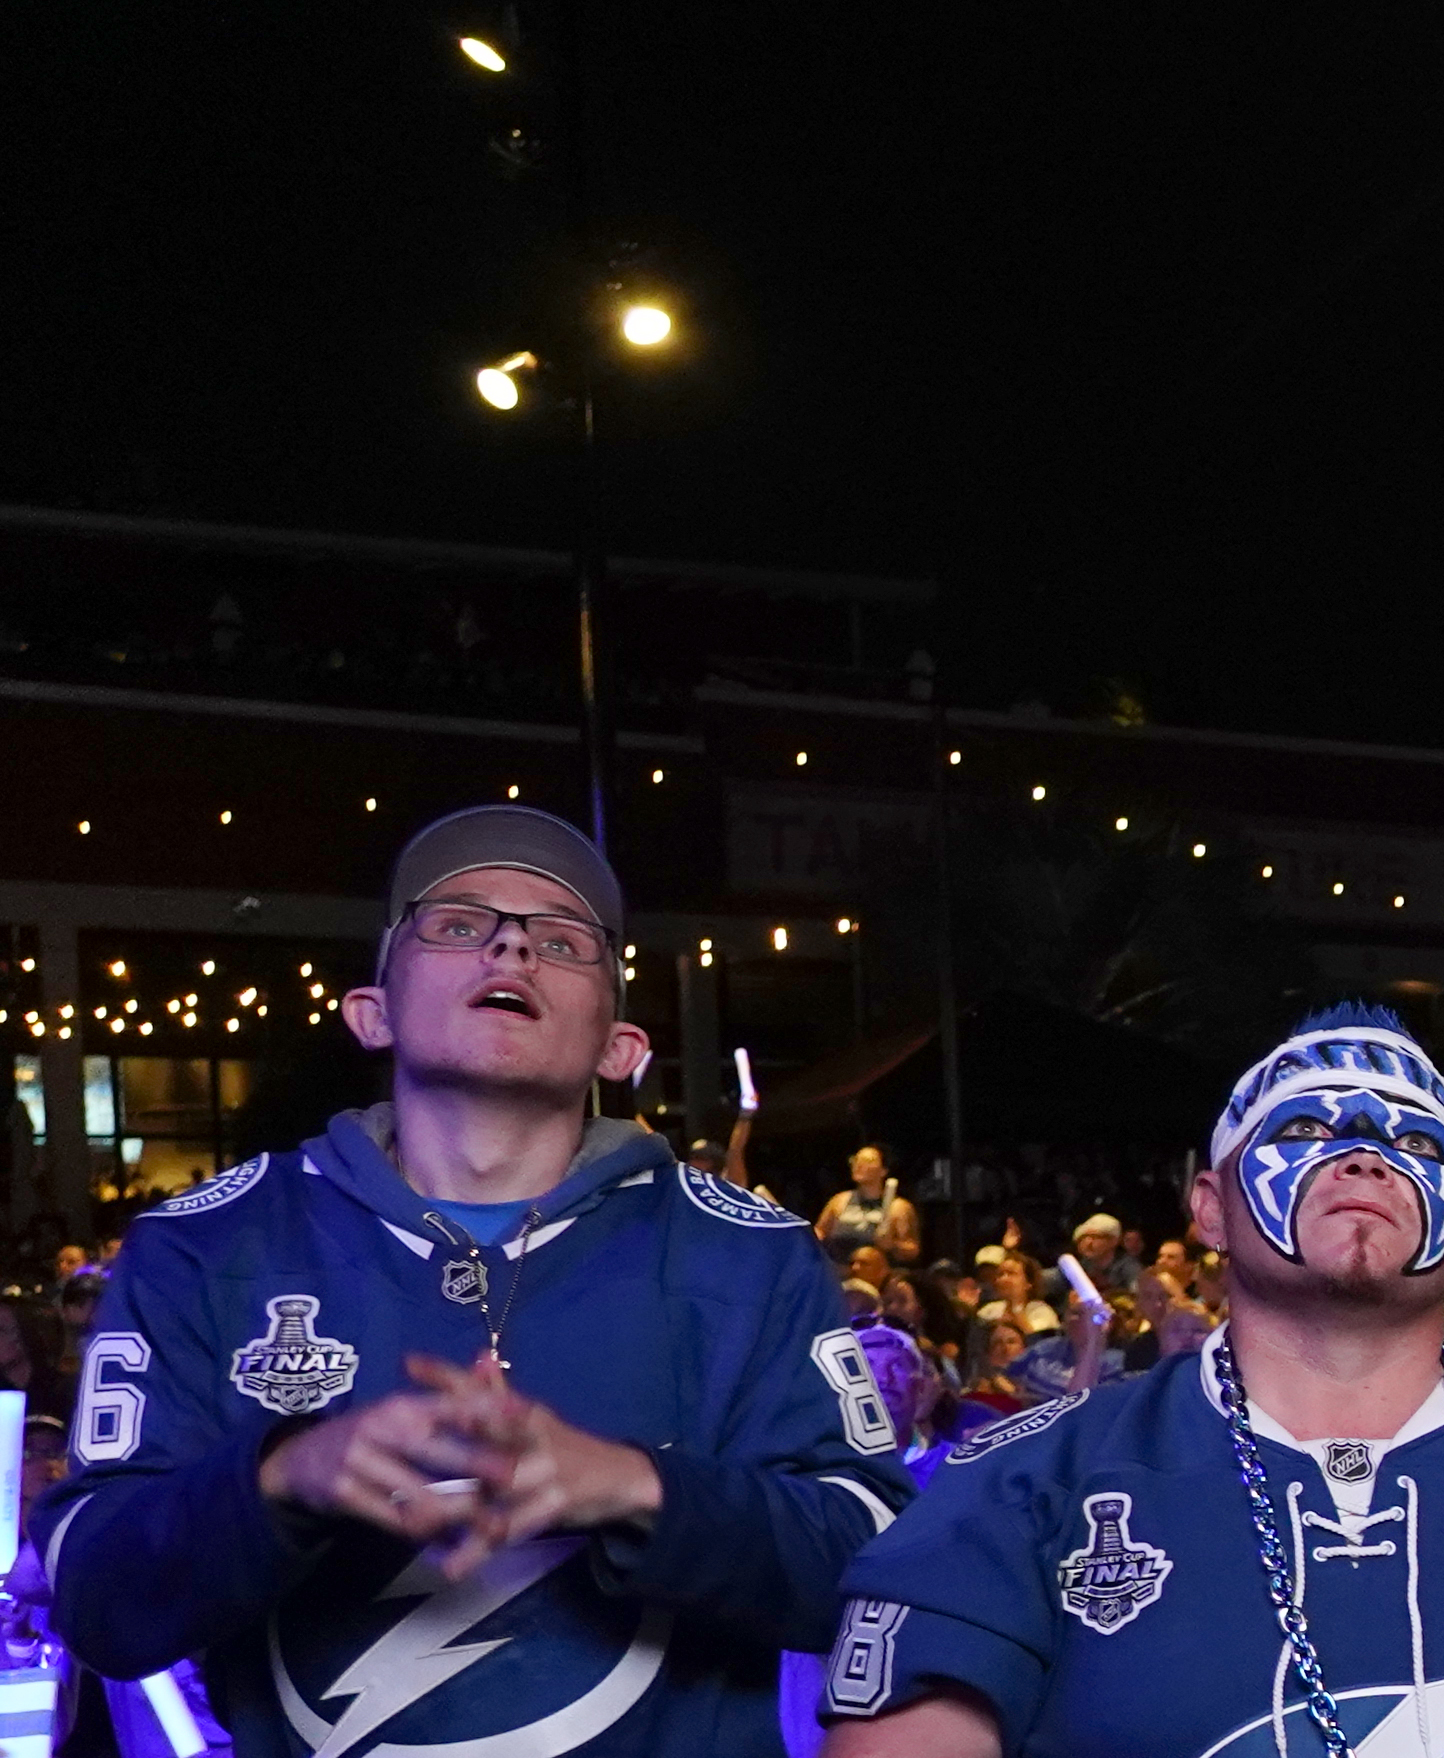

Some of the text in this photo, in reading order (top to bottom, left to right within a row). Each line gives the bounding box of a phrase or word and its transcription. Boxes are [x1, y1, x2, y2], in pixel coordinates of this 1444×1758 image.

[72, 1332, 151, 1464] 6
[239, 1352, 347, 1371] FINAL
[810, 1327, 897, 1456] 8
[1063, 1561, 1161, 1588] FINAL
[826, 1599, 910, 1717] 8
